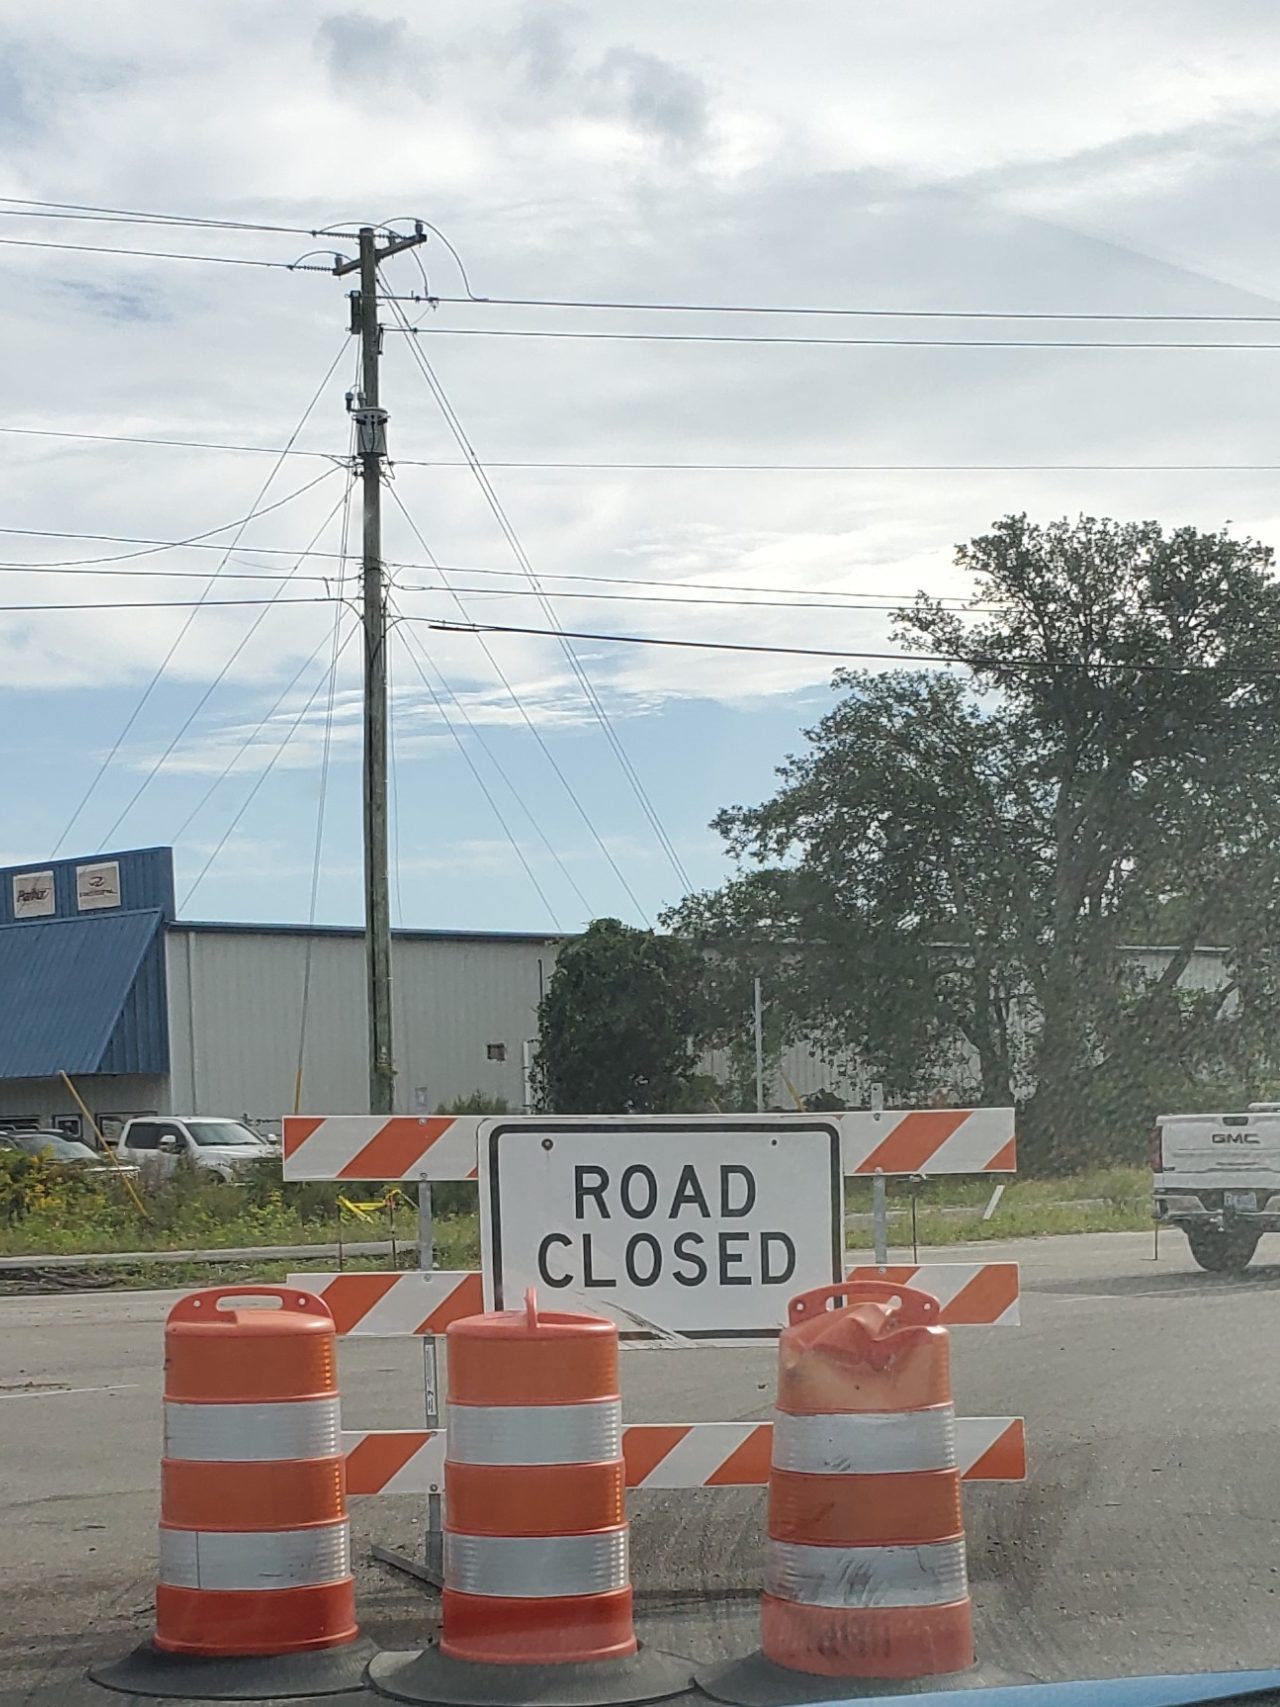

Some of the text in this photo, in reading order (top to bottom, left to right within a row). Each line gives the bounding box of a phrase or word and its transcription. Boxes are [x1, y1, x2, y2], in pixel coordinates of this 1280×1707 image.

[1212, 1133, 1261, 1144] GMC
[574, 1163, 757, 1220] ROAD
[537, 1230, 797, 1289] CLOSED
